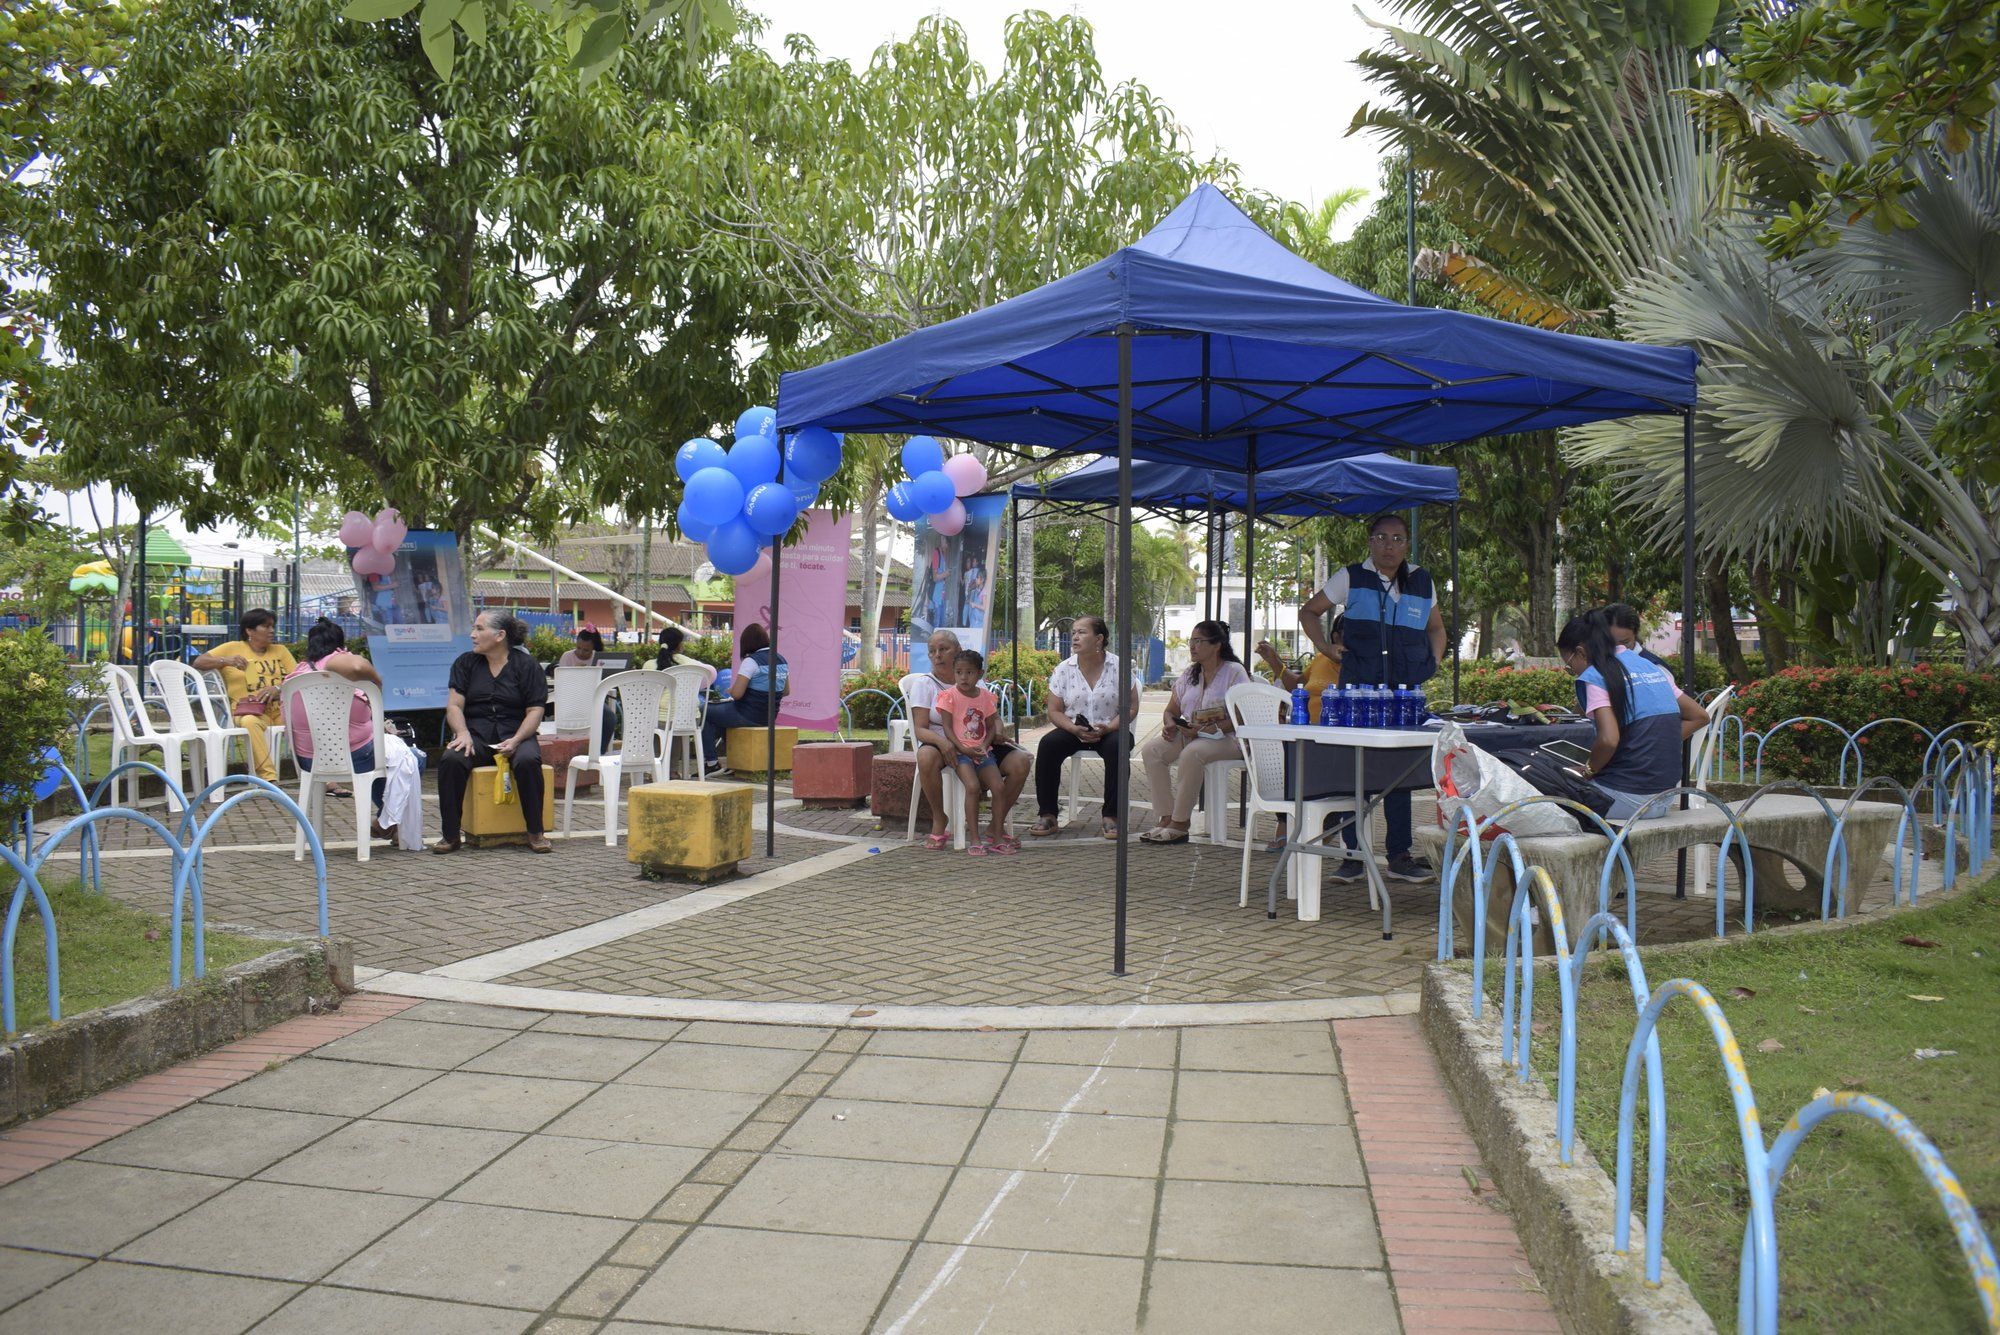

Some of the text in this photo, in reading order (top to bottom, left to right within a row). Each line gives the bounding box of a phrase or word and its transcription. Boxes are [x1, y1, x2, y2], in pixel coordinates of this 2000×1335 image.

[809, 544, 835, 552] minuto
[802, 552, 819, 561] para
[820, 554, 845, 562] cuidar
[254, 659, 289, 676] OVE
